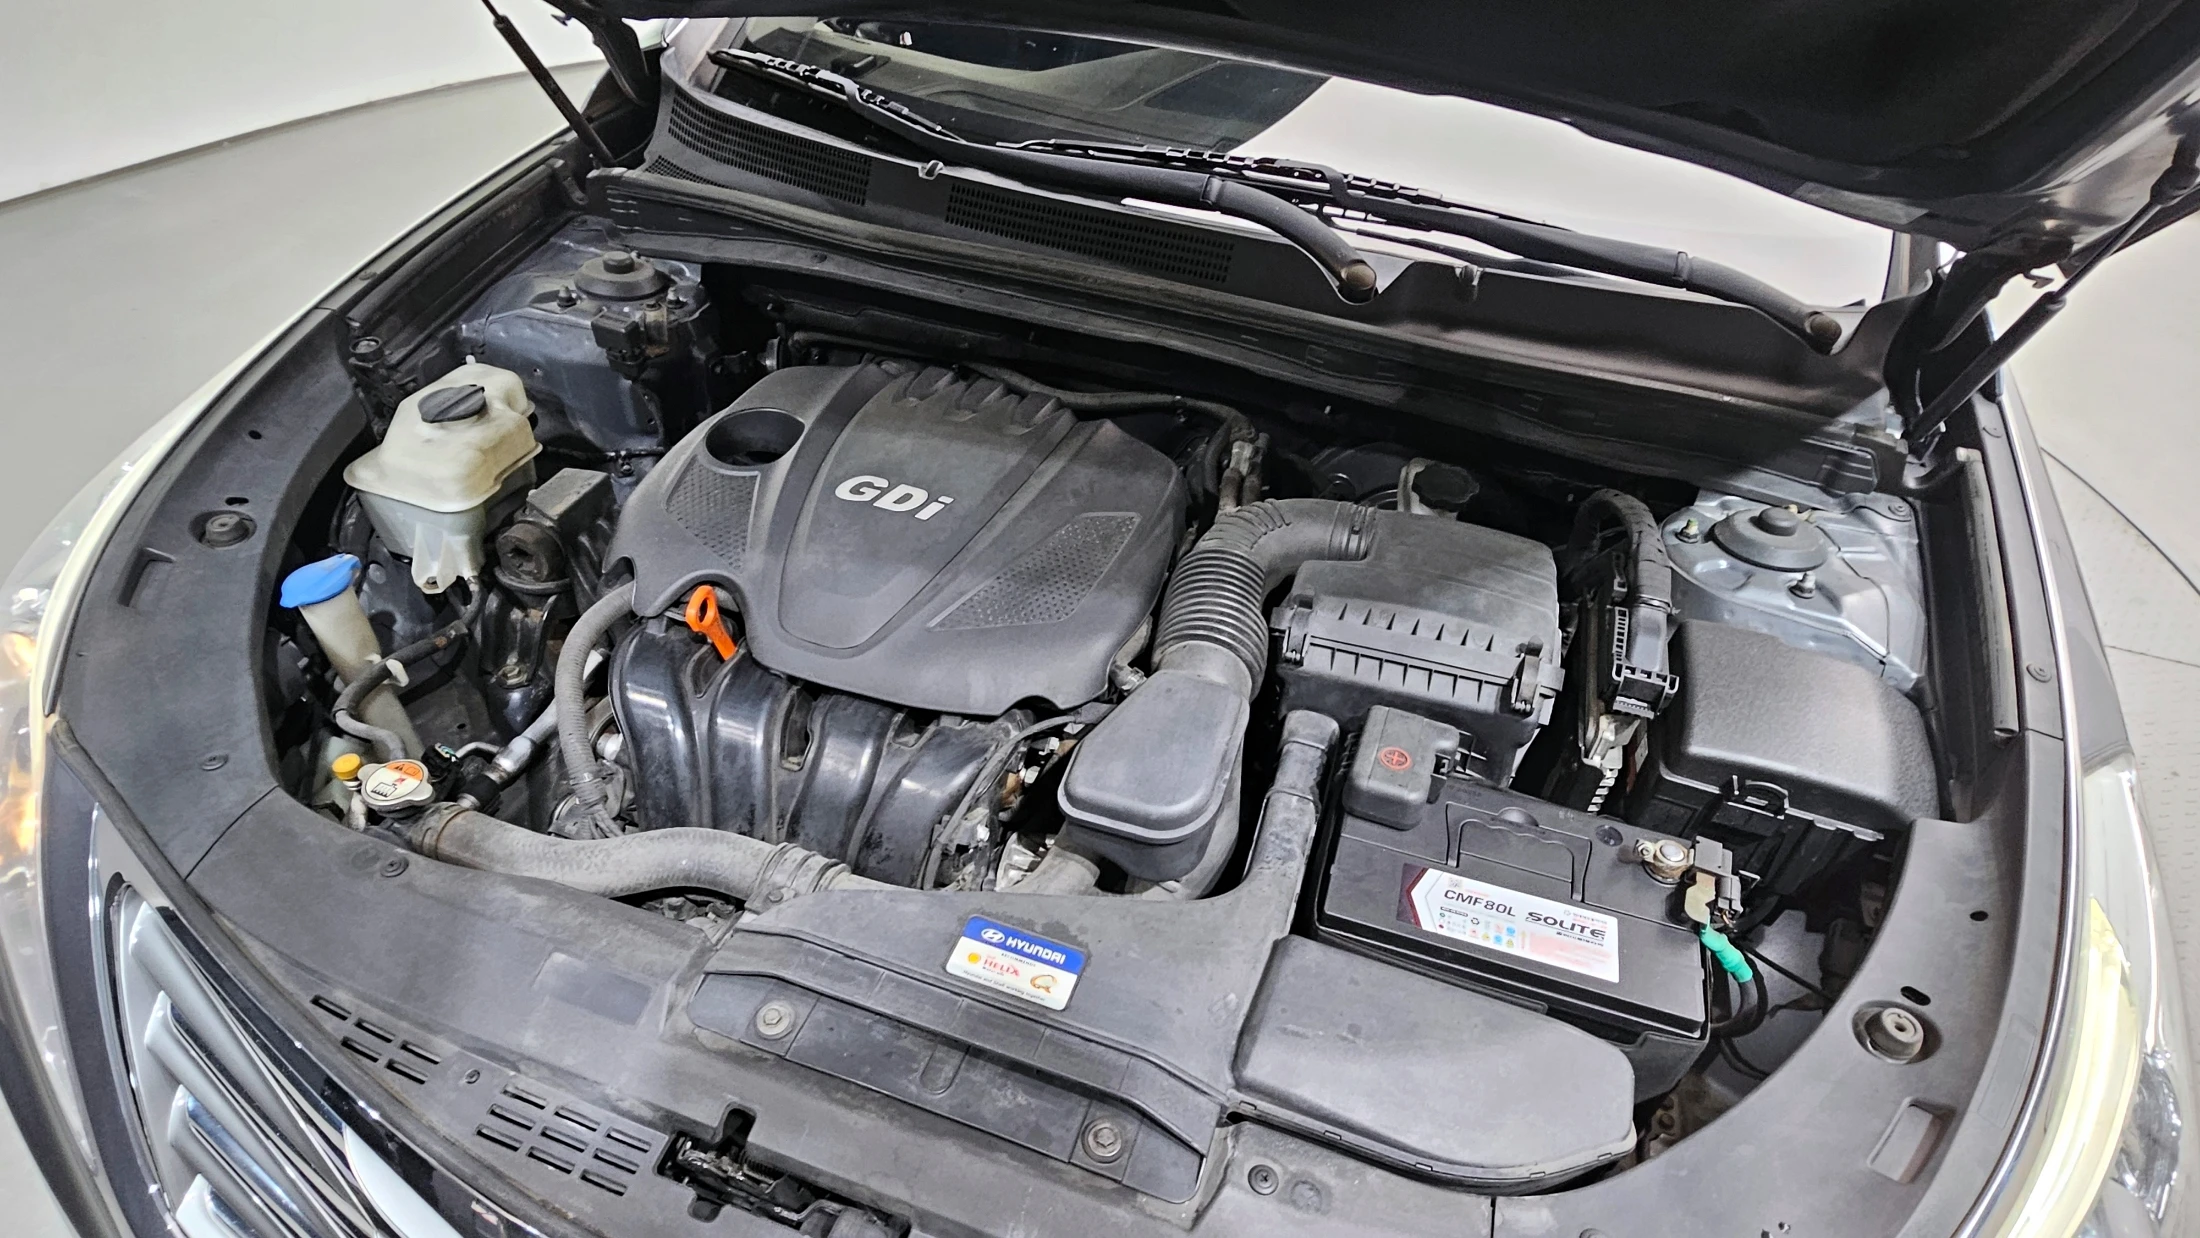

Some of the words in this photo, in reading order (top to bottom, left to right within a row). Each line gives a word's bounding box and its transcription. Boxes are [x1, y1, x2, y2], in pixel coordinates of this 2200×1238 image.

[834, 475, 955, 521] GDi
[1444, 889, 1516, 917] CMF80L
[1526, 911, 1607, 939] SOLITE
[1006, 936, 1066, 965] HYUNDAI
[984, 959, 1020, 976] HELIX
